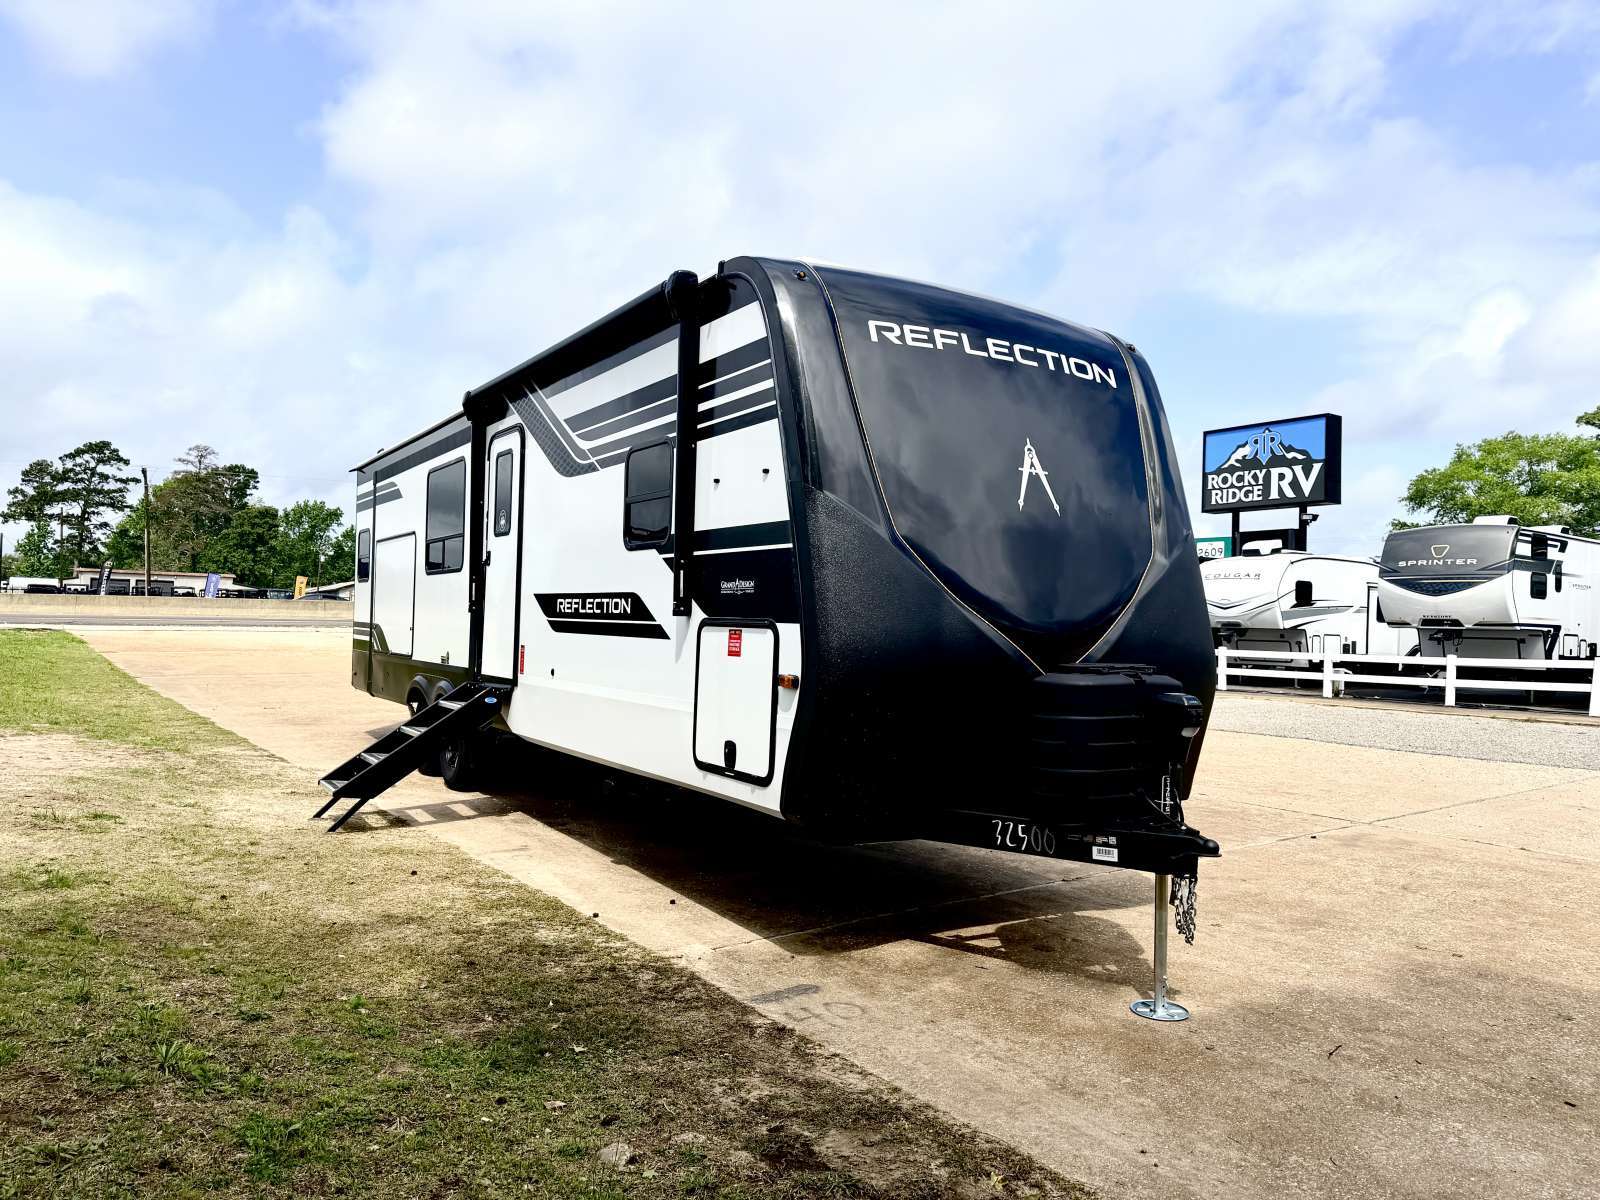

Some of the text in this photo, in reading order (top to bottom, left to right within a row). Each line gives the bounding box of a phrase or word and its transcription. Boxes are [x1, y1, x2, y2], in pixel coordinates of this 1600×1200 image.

[867, 319, 1118, 389] REFLECTION
[1207, 468, 1267, 490] ROCKY
[1267, 462, 1324, 500] RV
[1210, 485, 1263, 505] RIDGE
[1398, 558, 1478, 567] SPRINTER
[556, 597, 632, 615] REFLECTION
[991, 819, 1056, 855] 32500
